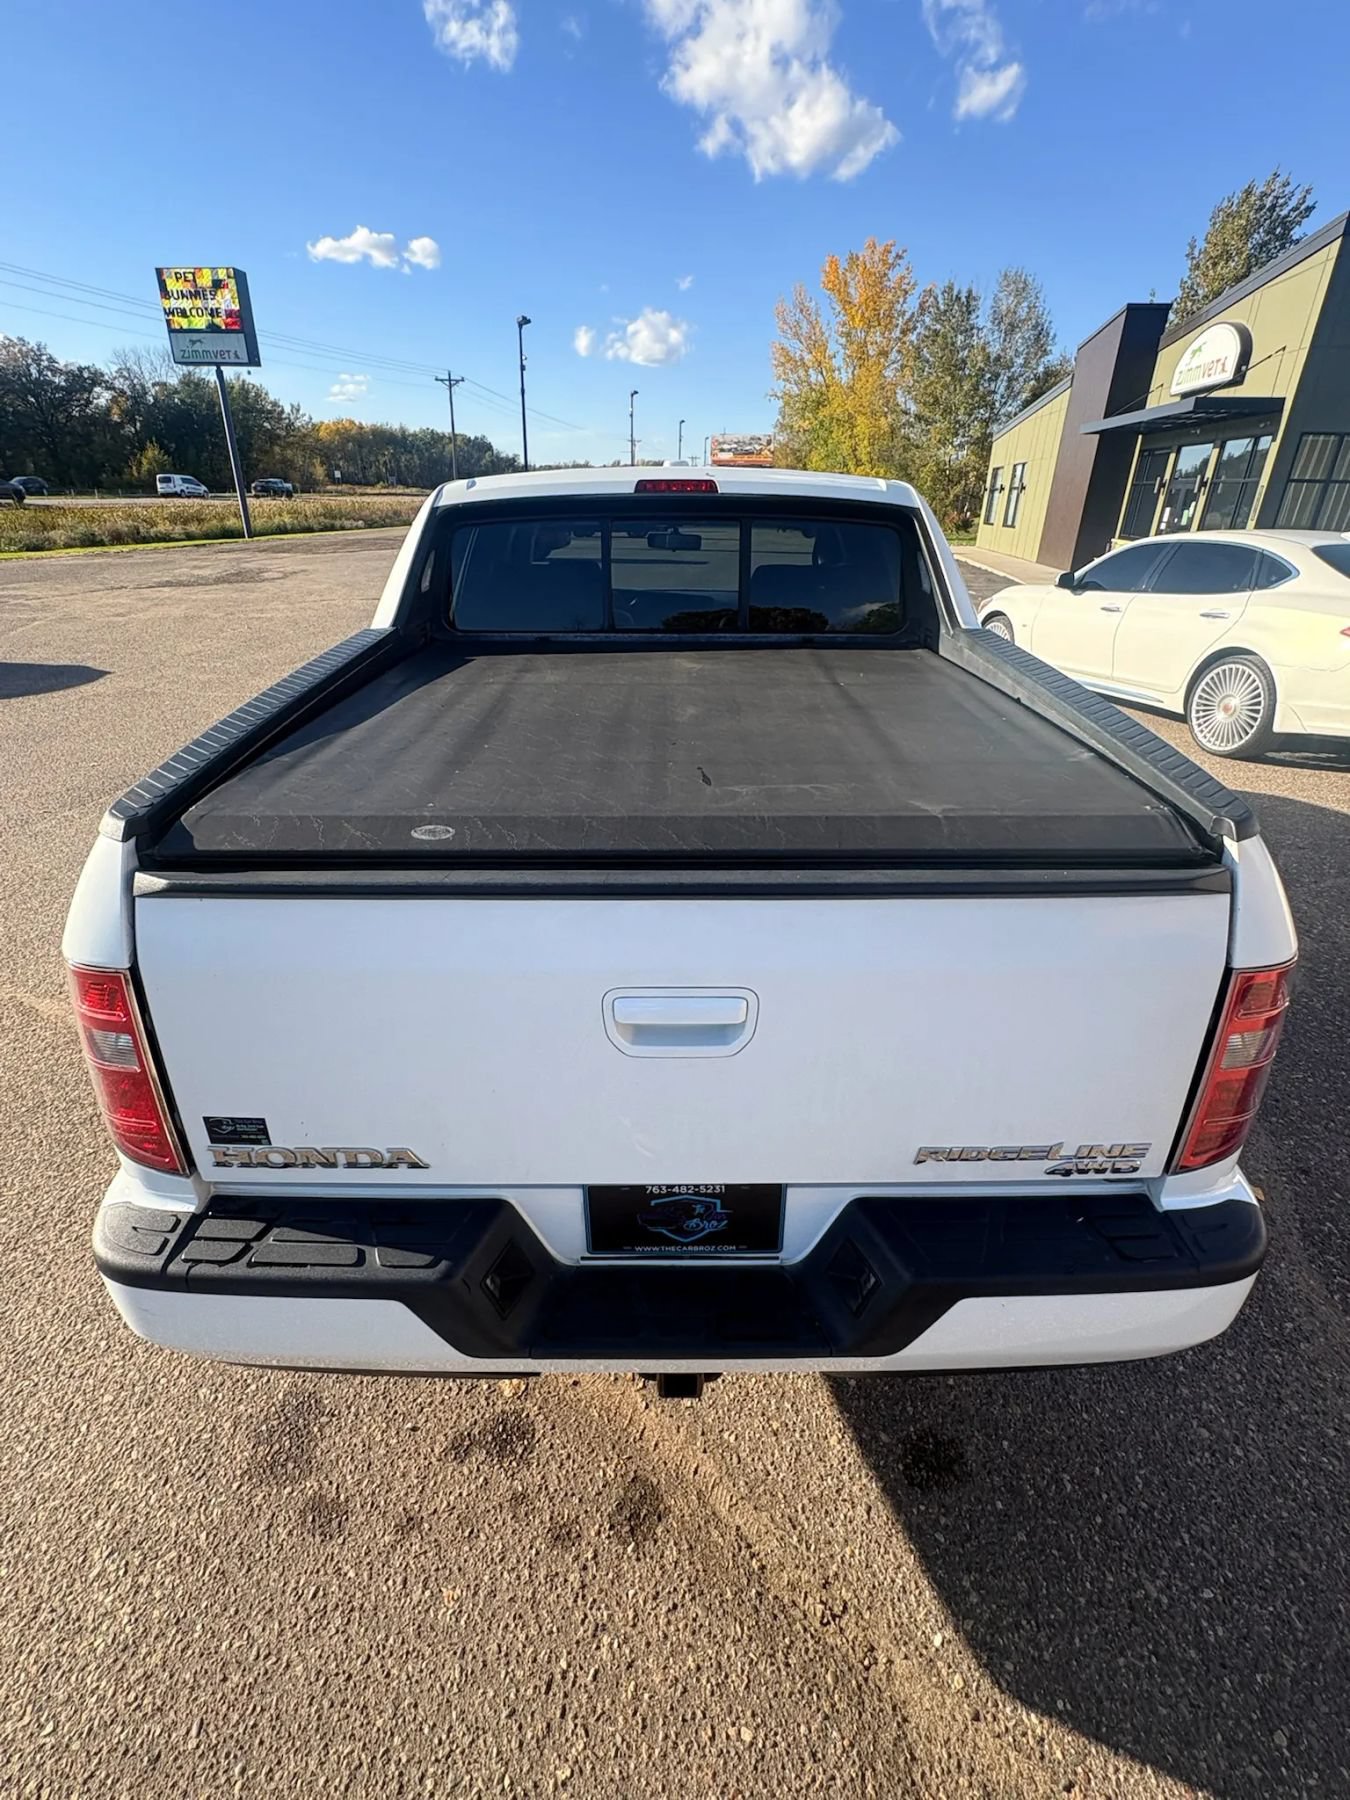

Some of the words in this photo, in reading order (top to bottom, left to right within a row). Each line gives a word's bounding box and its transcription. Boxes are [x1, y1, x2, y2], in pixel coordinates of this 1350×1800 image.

[207, 1146, 431, 1168] HONDA
[913, 1142, 1152, 1165] RIDGELINE
[1044, 1159, 1141, 1176] 4WD
[645, 1185, 726, 1194] 763-482-5231
